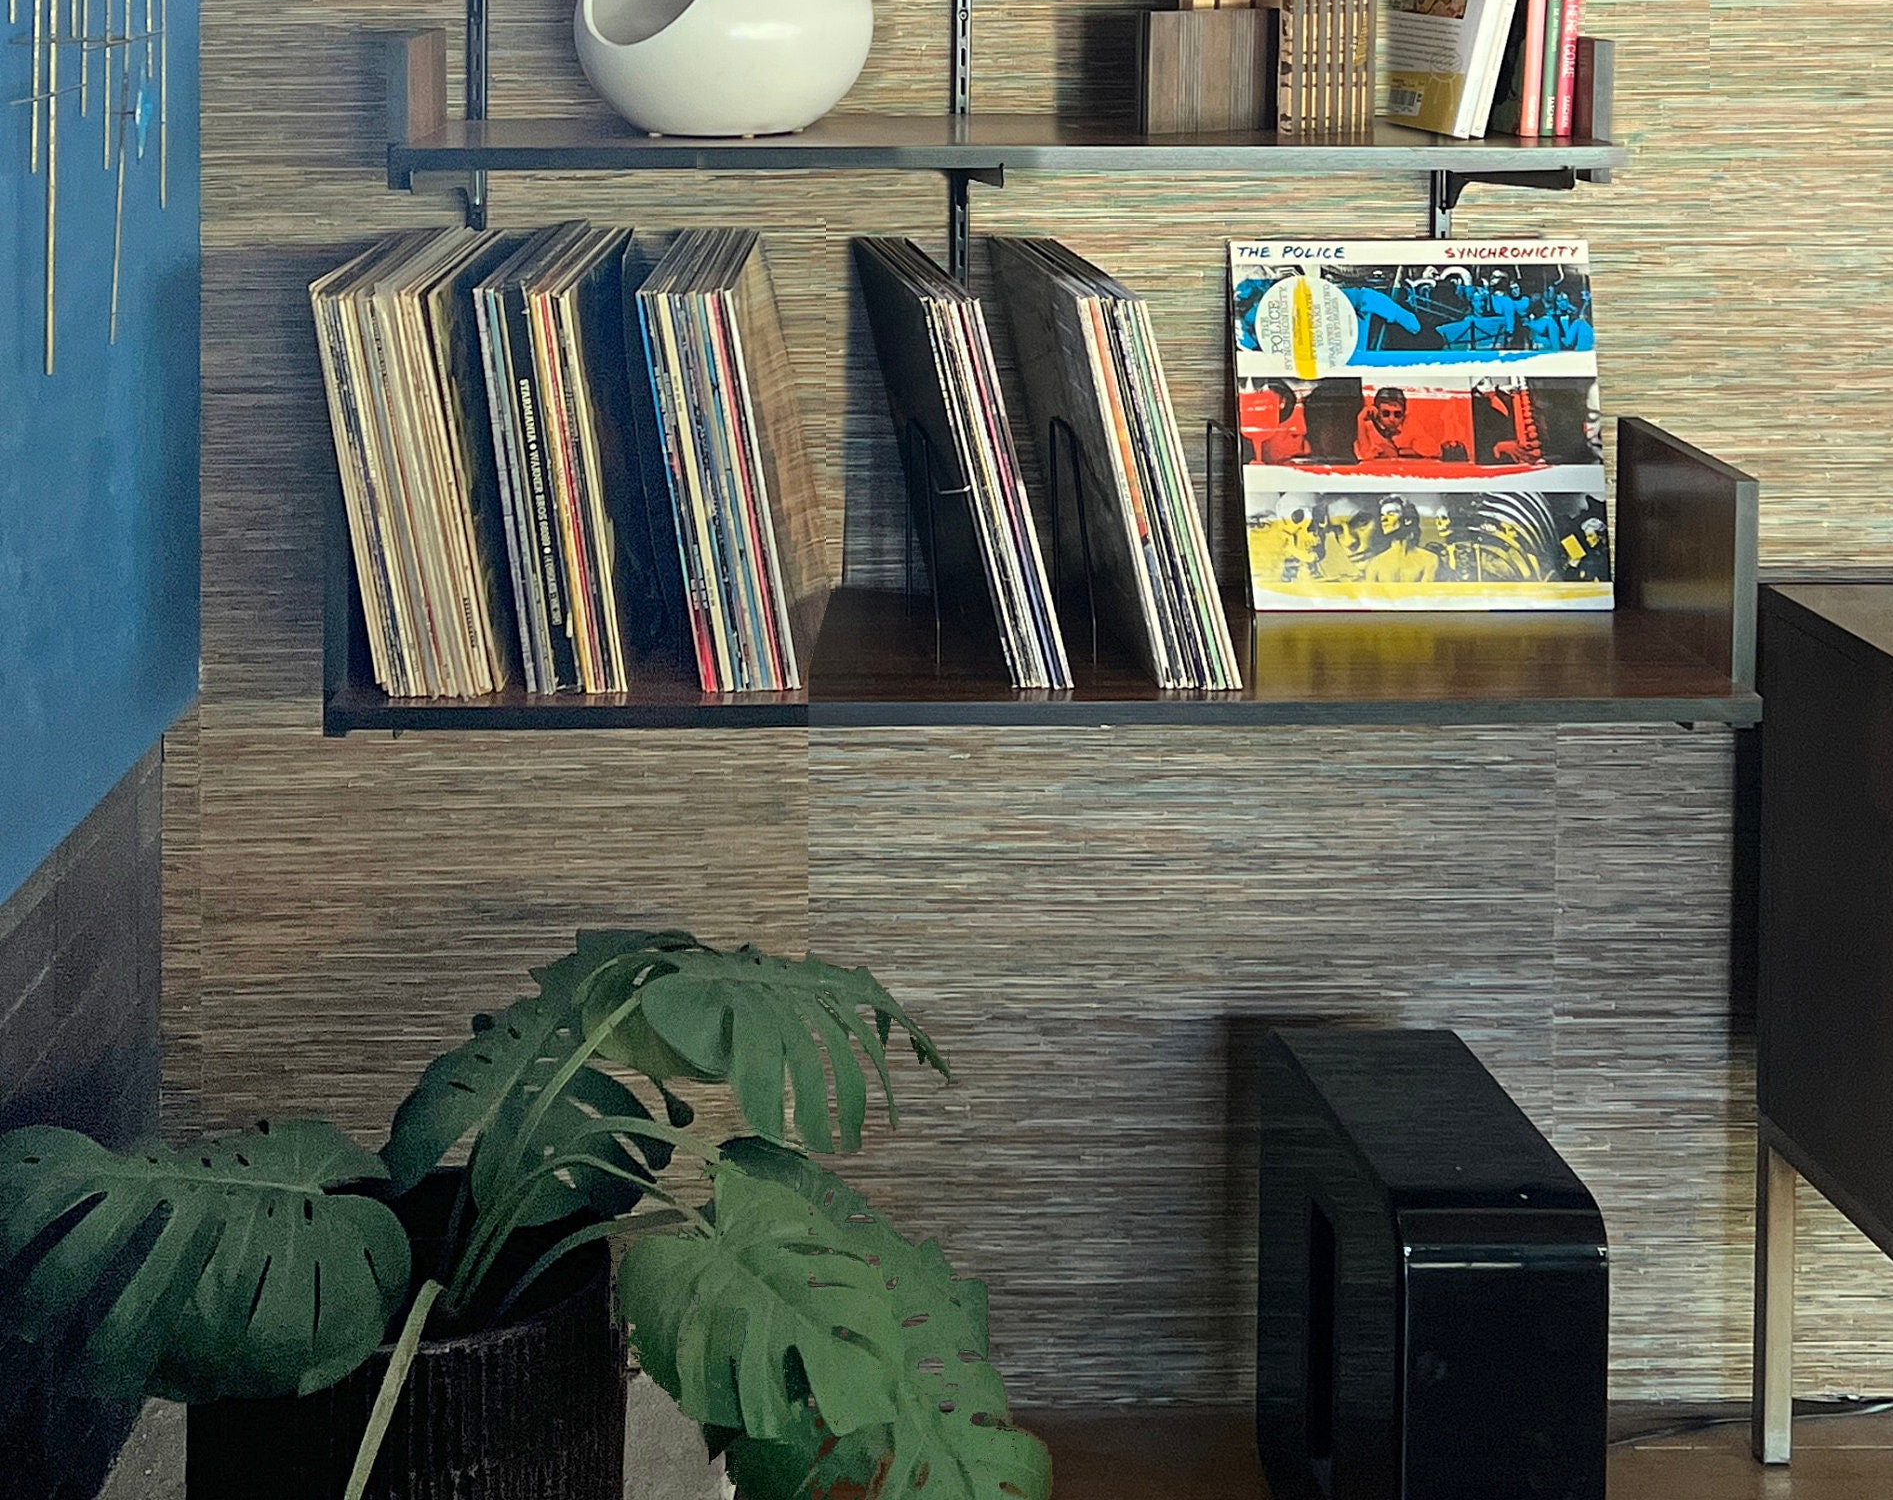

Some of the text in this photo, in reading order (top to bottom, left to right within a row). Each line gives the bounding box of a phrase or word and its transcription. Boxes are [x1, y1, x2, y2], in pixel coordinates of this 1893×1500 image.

[1564, 4, 1578, 34] HERE
[1562, 43, 1576, 78] COME
[1237, 246, 1345, 258] THE POLICE
[1445, 246, 1578, 259] SYNCHRONICITY
[1261, 316, 1269, 339] THE
[1268, 300, 1283, 354] POLICE
[1280, 286, 1293, 371] SYNCHRONICITY
[519, 379, 536, 443] STARMANIA
[529, 451, 543, 494] WARNER
[535, 494, 547, 520] BROS
